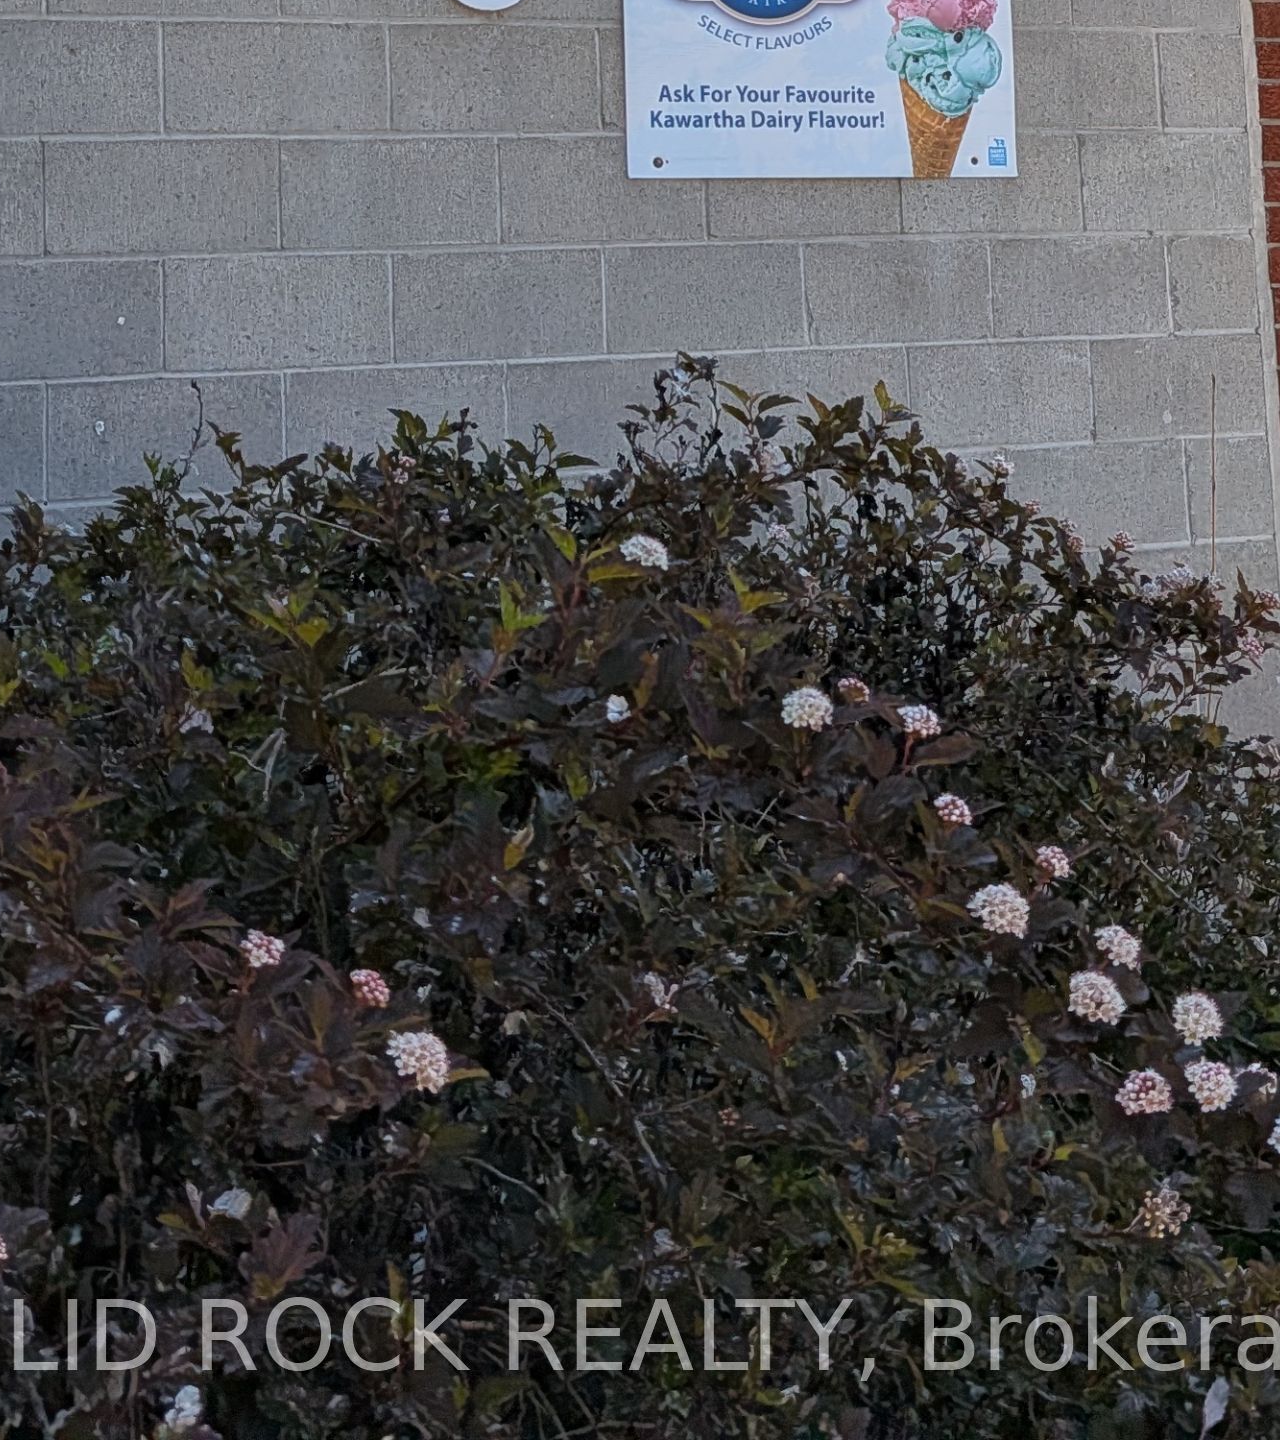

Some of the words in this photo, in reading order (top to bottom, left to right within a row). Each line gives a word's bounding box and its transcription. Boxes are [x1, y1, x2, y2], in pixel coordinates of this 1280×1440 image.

[697, 14, 753, 49] SELECT
[755, 15, 834, 50] FLAVOURS
[658, 84, 696, 104] Ask
[699, 85, 732, 104] For
[735, 85, 782, 105] Your
[785, 84, 876, 105] Favourite
[649, 110, 747, 130] Kawartha
[750, 110, 804, 133] Dairy
[807, 109, 886, 130] Flavour!
